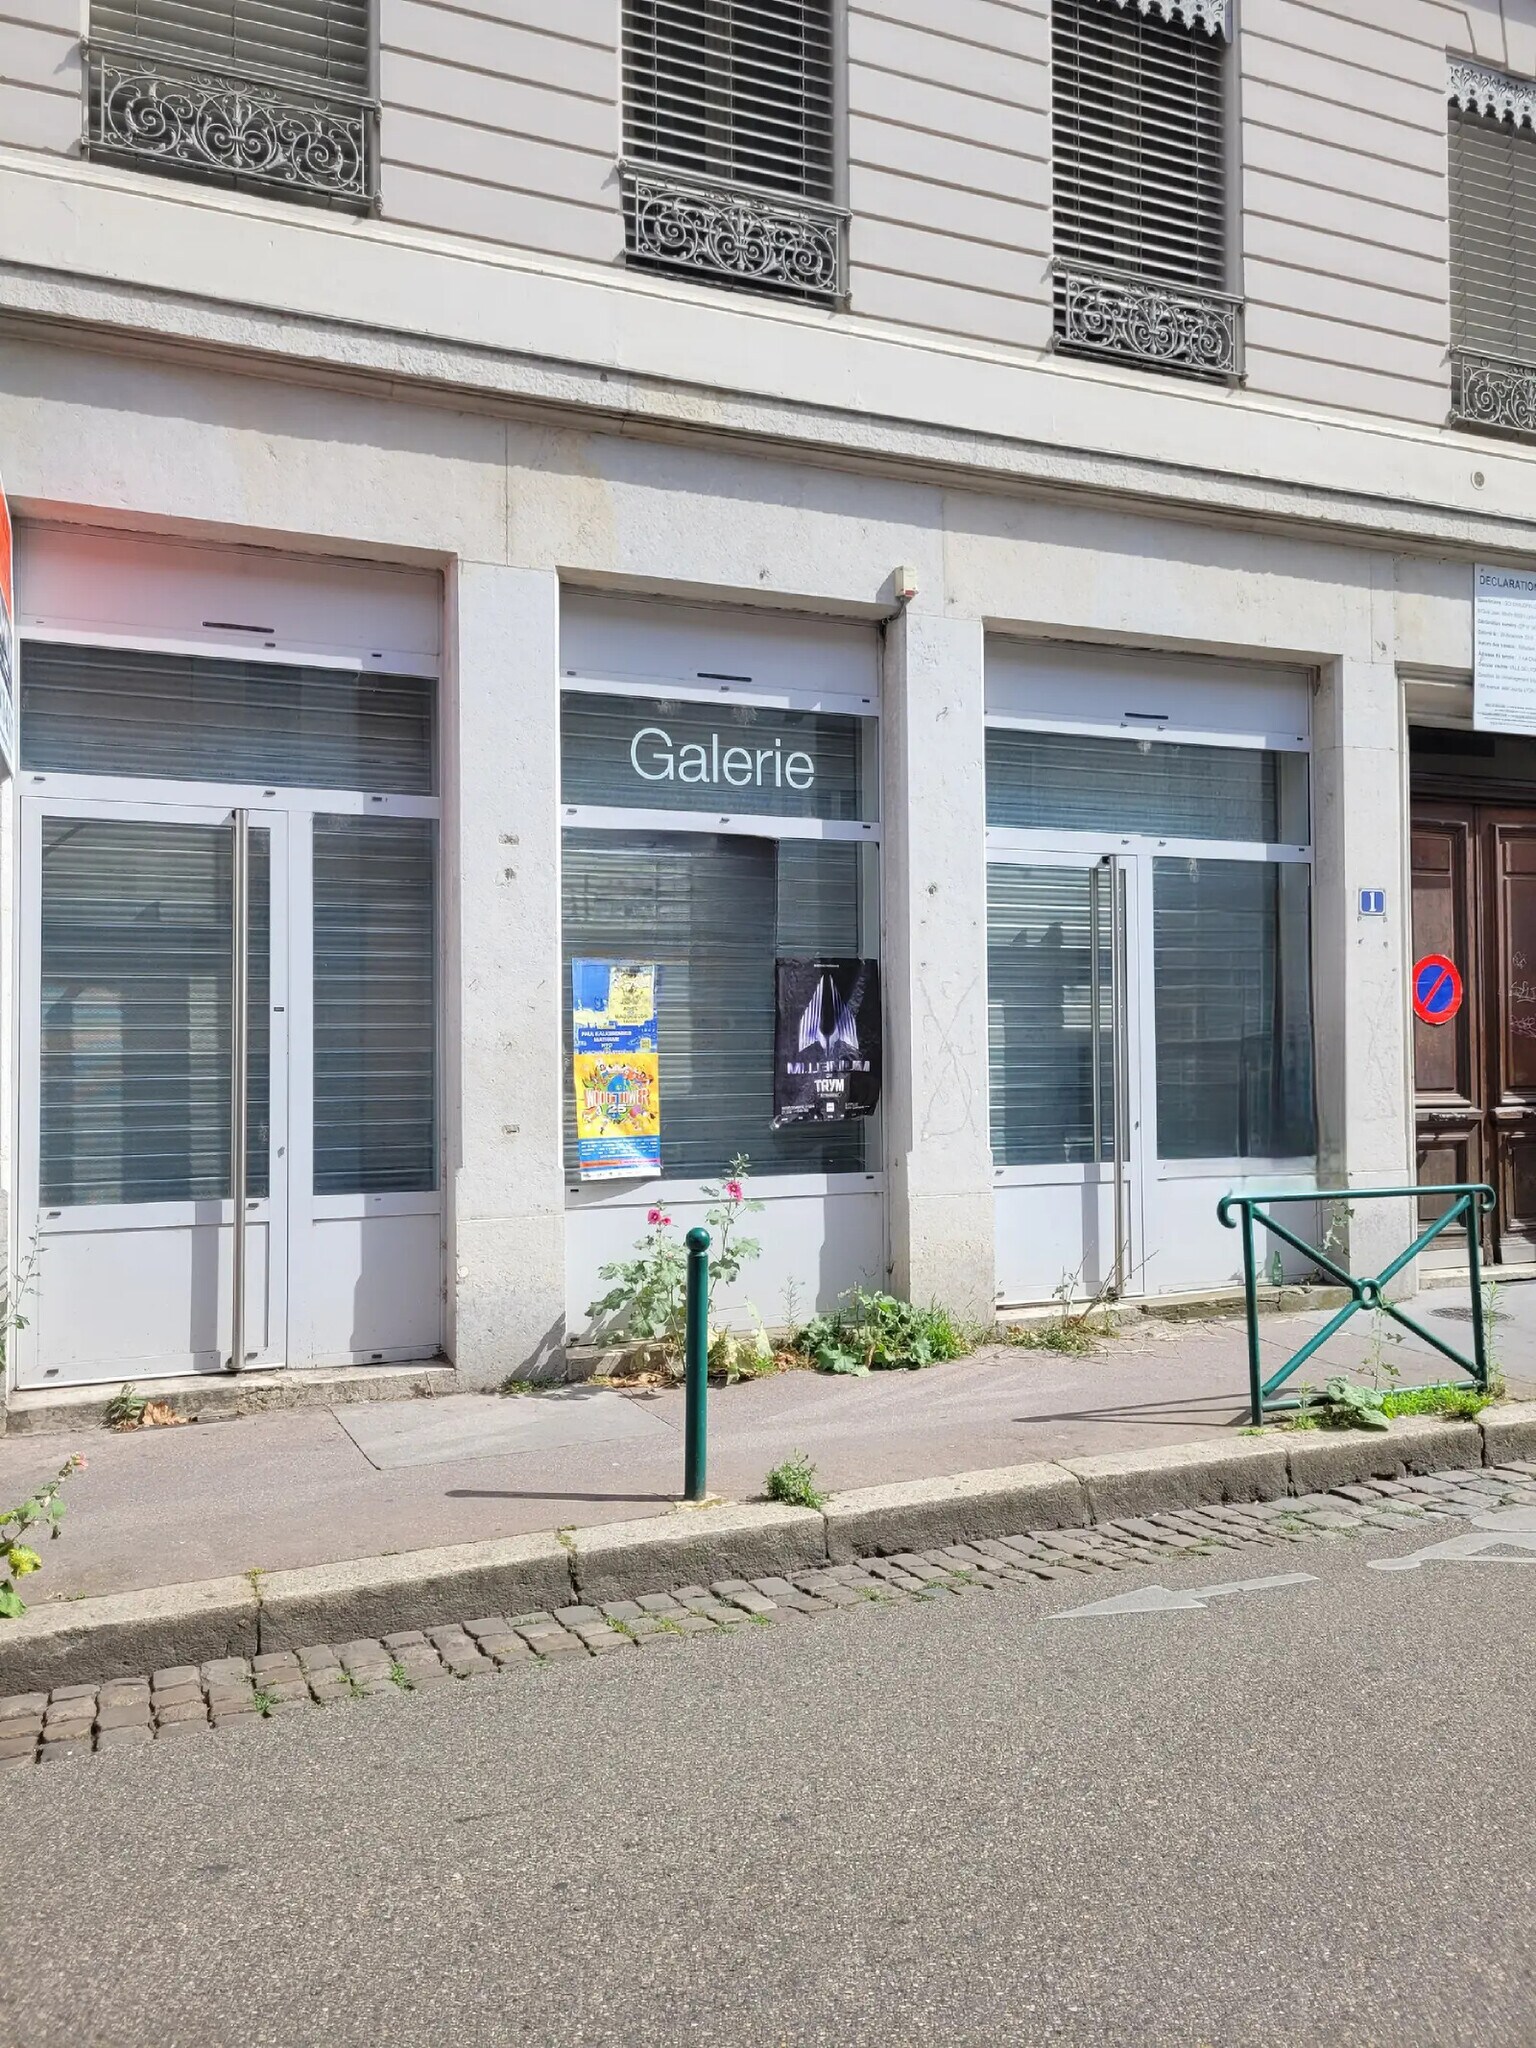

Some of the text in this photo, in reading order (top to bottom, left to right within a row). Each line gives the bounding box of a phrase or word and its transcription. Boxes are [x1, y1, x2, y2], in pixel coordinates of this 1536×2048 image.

[630, 727, 815, 790] Galerie
[1369, 892, 1377, 912] 1
[814, 1079, 845, 1093] TRYM
[606, 1103, 628, 1114] 25
